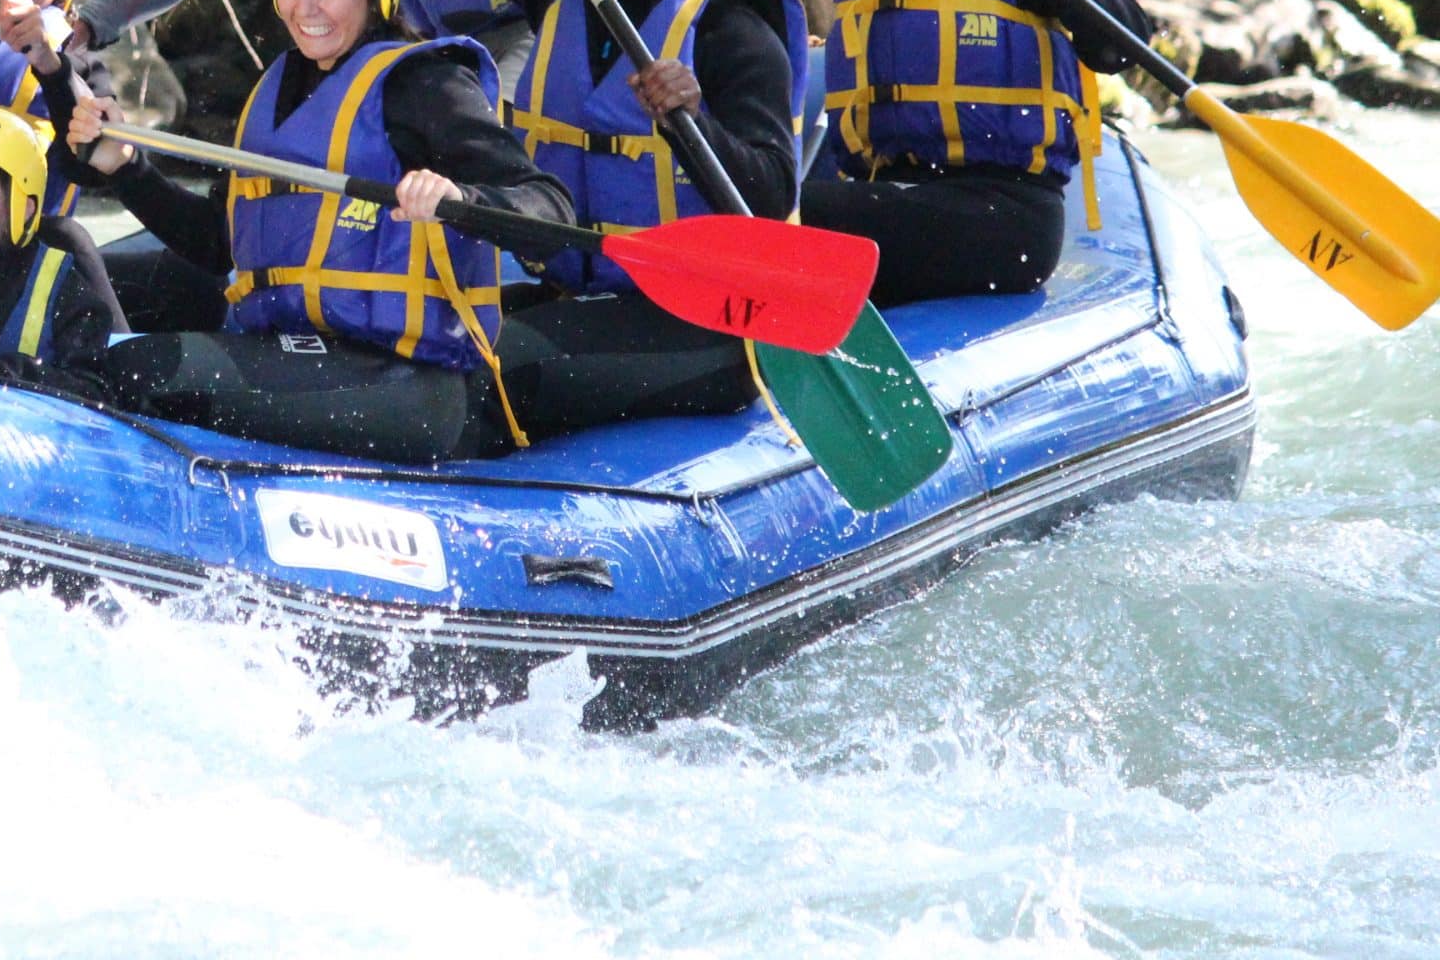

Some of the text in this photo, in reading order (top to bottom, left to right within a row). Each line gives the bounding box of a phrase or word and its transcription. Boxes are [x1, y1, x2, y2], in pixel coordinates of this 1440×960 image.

[960, 13, 997, 38] AN
[959, 37, 997, 47] RAFTING
[341, 197, 381, 224] AN
